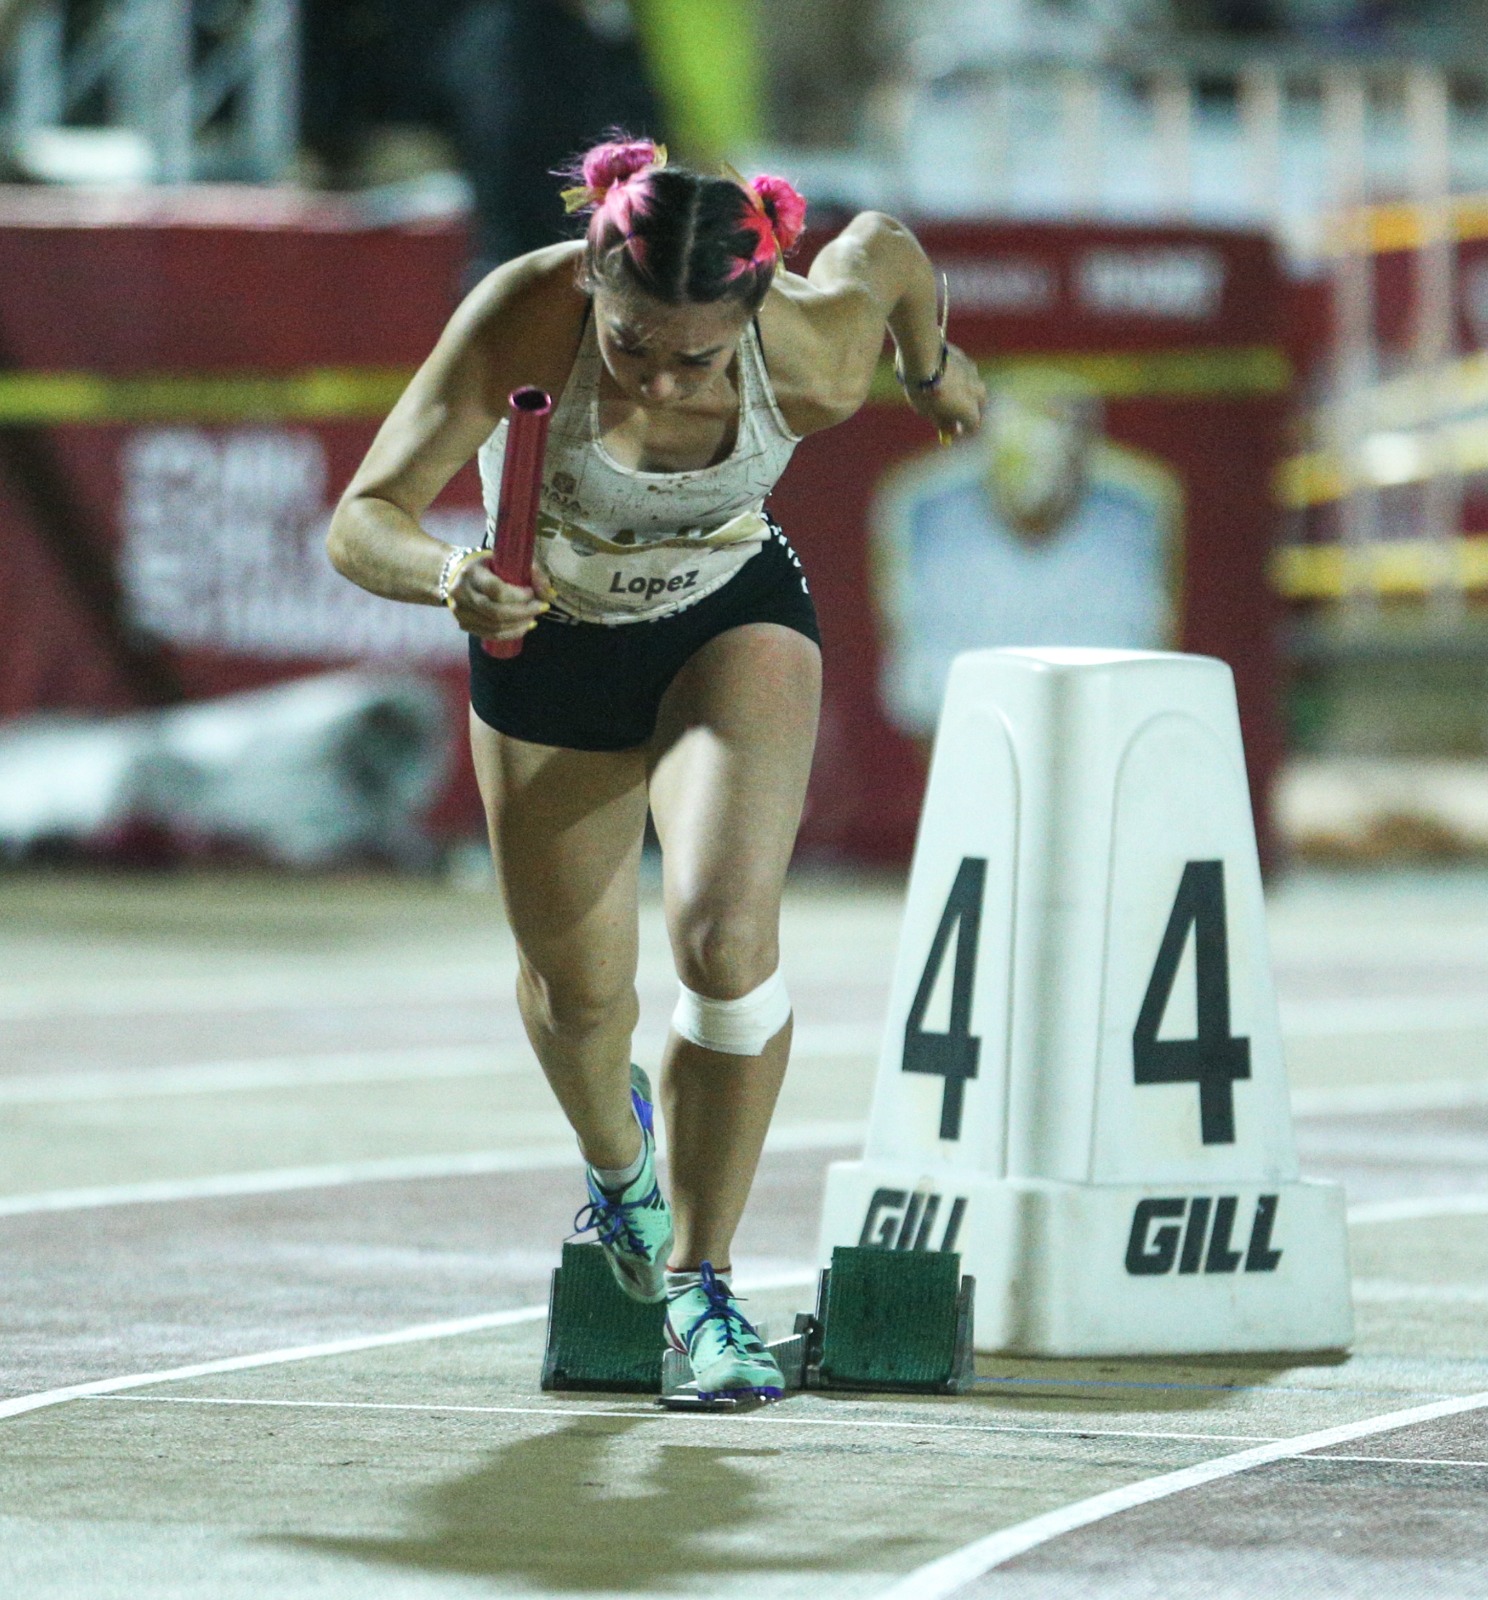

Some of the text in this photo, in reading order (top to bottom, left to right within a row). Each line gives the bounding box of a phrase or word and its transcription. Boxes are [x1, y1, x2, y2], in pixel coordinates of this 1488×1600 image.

[609, 570, 700, 601] Lopez
[902, 857, 988, 1142] 4
[1133, 860, 1252, 1145] 4
[1125, 1195, 1283, 1276] GILL
